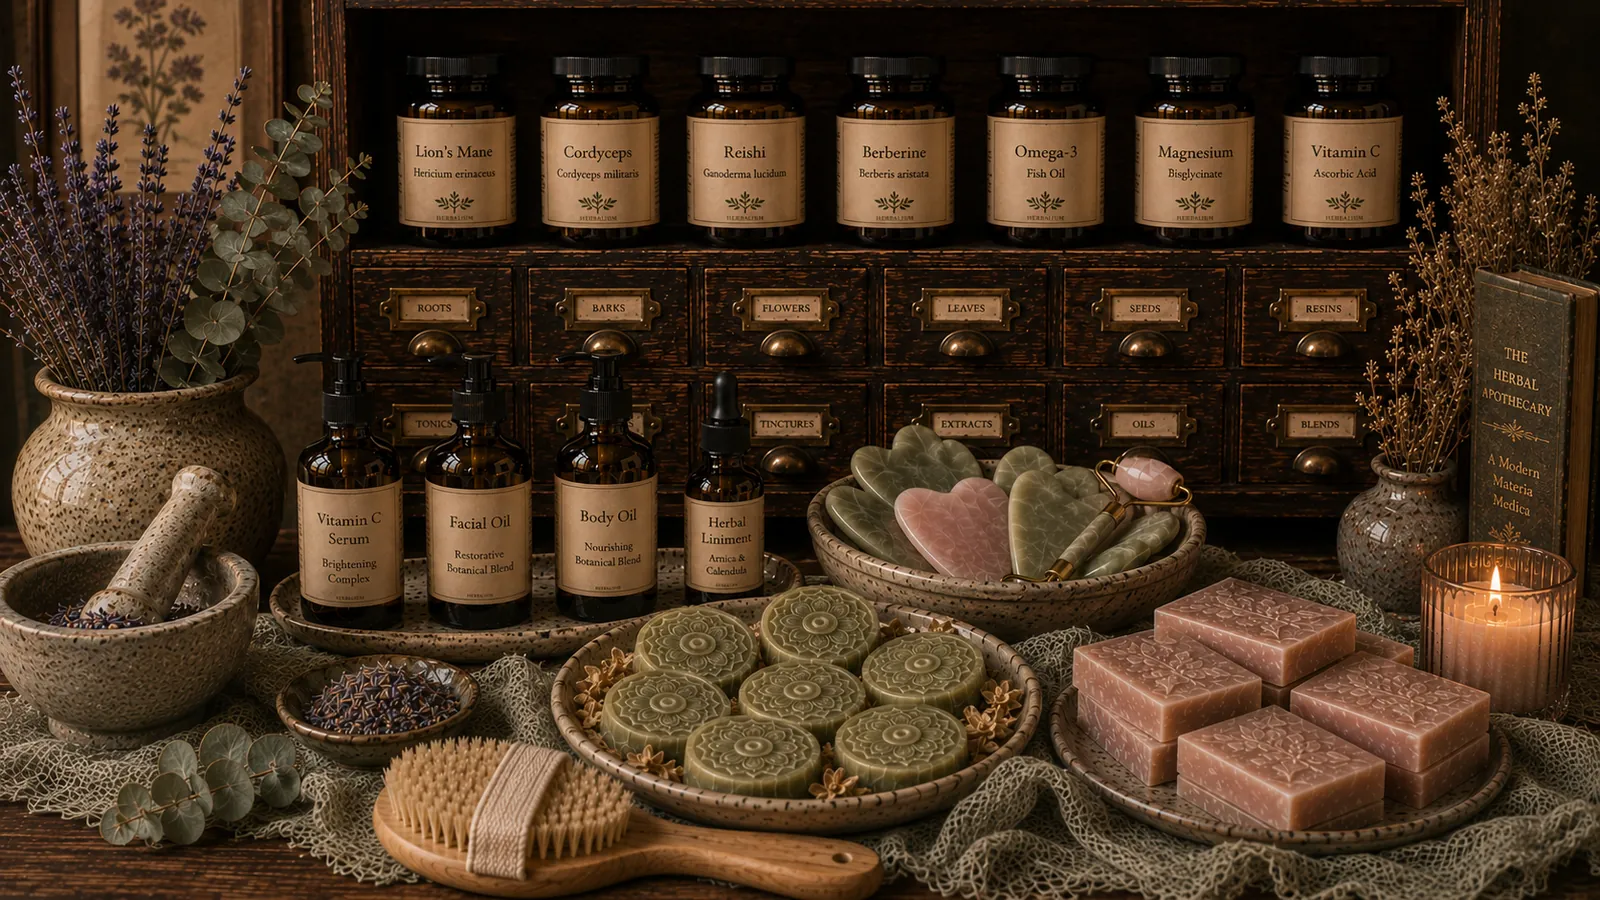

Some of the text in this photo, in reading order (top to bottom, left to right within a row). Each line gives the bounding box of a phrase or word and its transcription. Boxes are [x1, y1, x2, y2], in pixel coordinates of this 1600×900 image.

[416, 145, 492, 158] Lion's Mane
[564, 146, 632, 162] Cordyceps
[724, 146, 765, 158] Reishi
[863, 146, 926, 159] Berberine
[1015, 145, 1077, 162] Omega-3
[1158, 145, 1233, 163] Magnesium
[1311, 145, 1380, 158] Vitamin C
[414, 167, 495, 178] Hericium erinaceus
[557, 168, 639, 181] Cordyceps militaris
[703, 168, 786, 178] Ganoderma lucidum
[859, 169, 929, 178] Berberis aristata
[1027, 168, 1065, 178] Fish Oil
[1168, 168, 1222, 181] Bisglycinate
[1314, 168, 1376, 178] Ascorbic Acid
[418, 304, 451, 312] ROOTS
[593, 304, 625, 312] BARKS
[763, 304, 810, 312] FLOWERS
[948, 304, 985, 312] LEAVES
[1130, 305, 1160, 313] SEEDS
[1306, 305, 1341, 313] RESINS
[1504, 346, 1528, 364] THE
[1494, 368, 1539, 391] HERBAL
[1482, 388, 1552, 417] APOTHECARY
[415, 419, 453, 429] TONICS
[760, 420, 814, 428] TINCTURES
[942, 420, 993, 429] EXTRACTS
[1132, 420, 1155, 428] OILS
[1301, 421, 1339, 429] BLENDS
[1488, 454, 1540, 479] A Modern
[1493, 475, 1533, 497] Materia
[1493, 493, 1530, 517] Medica
[317, 512, 381, 526] Vitamin C
[450, 515, 510, 529] Facial Oil
[581, 508, 636, 527] Body Oil
[709, 517, 745, 528] Herbal
[329, 532, 369, 545] Serum
[702, 533, 751, 544] Liniment
[585, 542, 633, 552] Nourishing
[455, 550, 504, 560] Restorative
[576, 554, 641, 566] Botanical Blend
[709, 554, 745, 563] Arnica &
[322, 558, 376, 572] Brightening
[447, 561, 513, 574] Botanical Blend
[706, 563, 746, 575] Calendula
[328, 573, 370, 587] Complex
